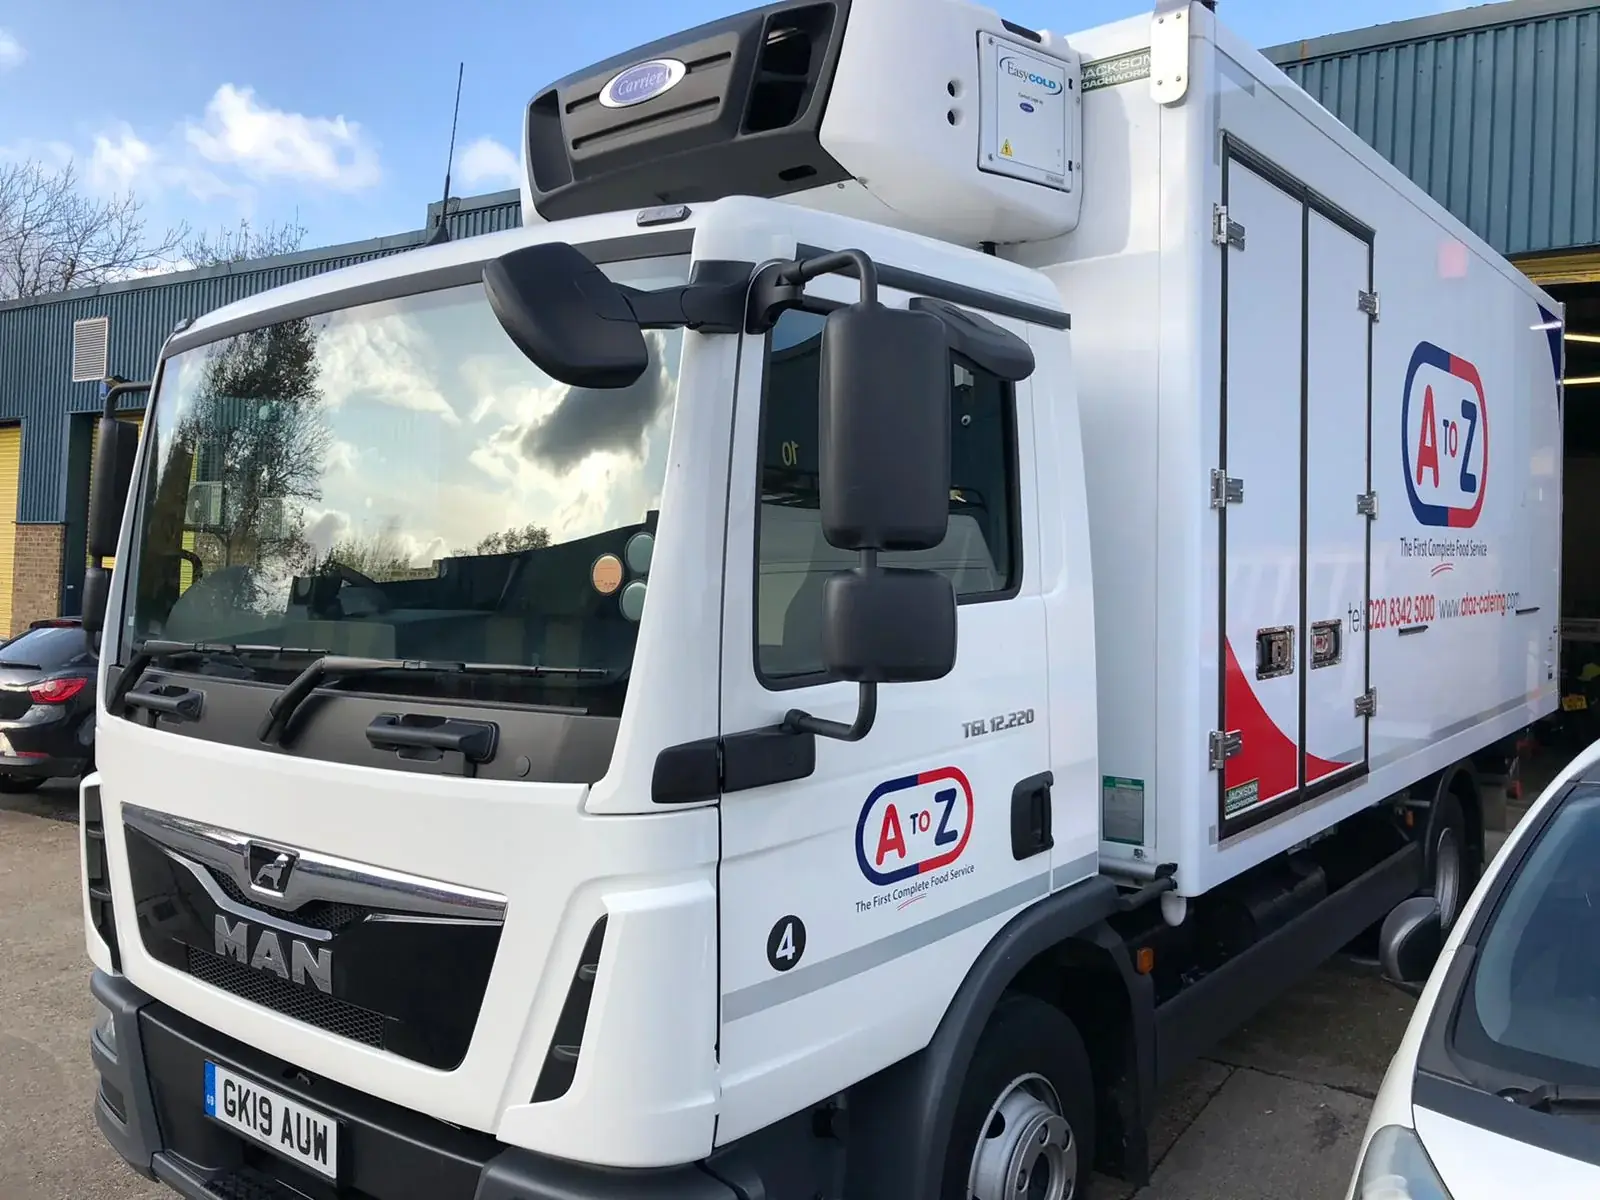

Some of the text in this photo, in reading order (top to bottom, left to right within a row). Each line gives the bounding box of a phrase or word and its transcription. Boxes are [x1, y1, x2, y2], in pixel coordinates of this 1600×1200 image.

[618, 71, 665, 96] Carrier
[1007, 61, 1056, 89] EasyCOLD
[1082, 67, 1150, 90] OACHWORK
[1416, 384, 1477, 493] A TO Z
[1400, 537, 1487, 561] The First Complete Food Service
[1347, 600, 1366, 634] tel:
[1368, 597, 1387, 630] 020
[1389, 594, 1412, 627] 8342
[1414, 593, 1435, 623] 5000
[962, 708, 1034, 739] TGL 12.220
[875, 788, 958, 866] A TO Z
[855, 864, 975, 913] The First Complete Food Service
[215, 914, 333, 995] MAN
[776, 922, 795, 960] 4
[223, 1078, 328, 1166] GK19 AUW
